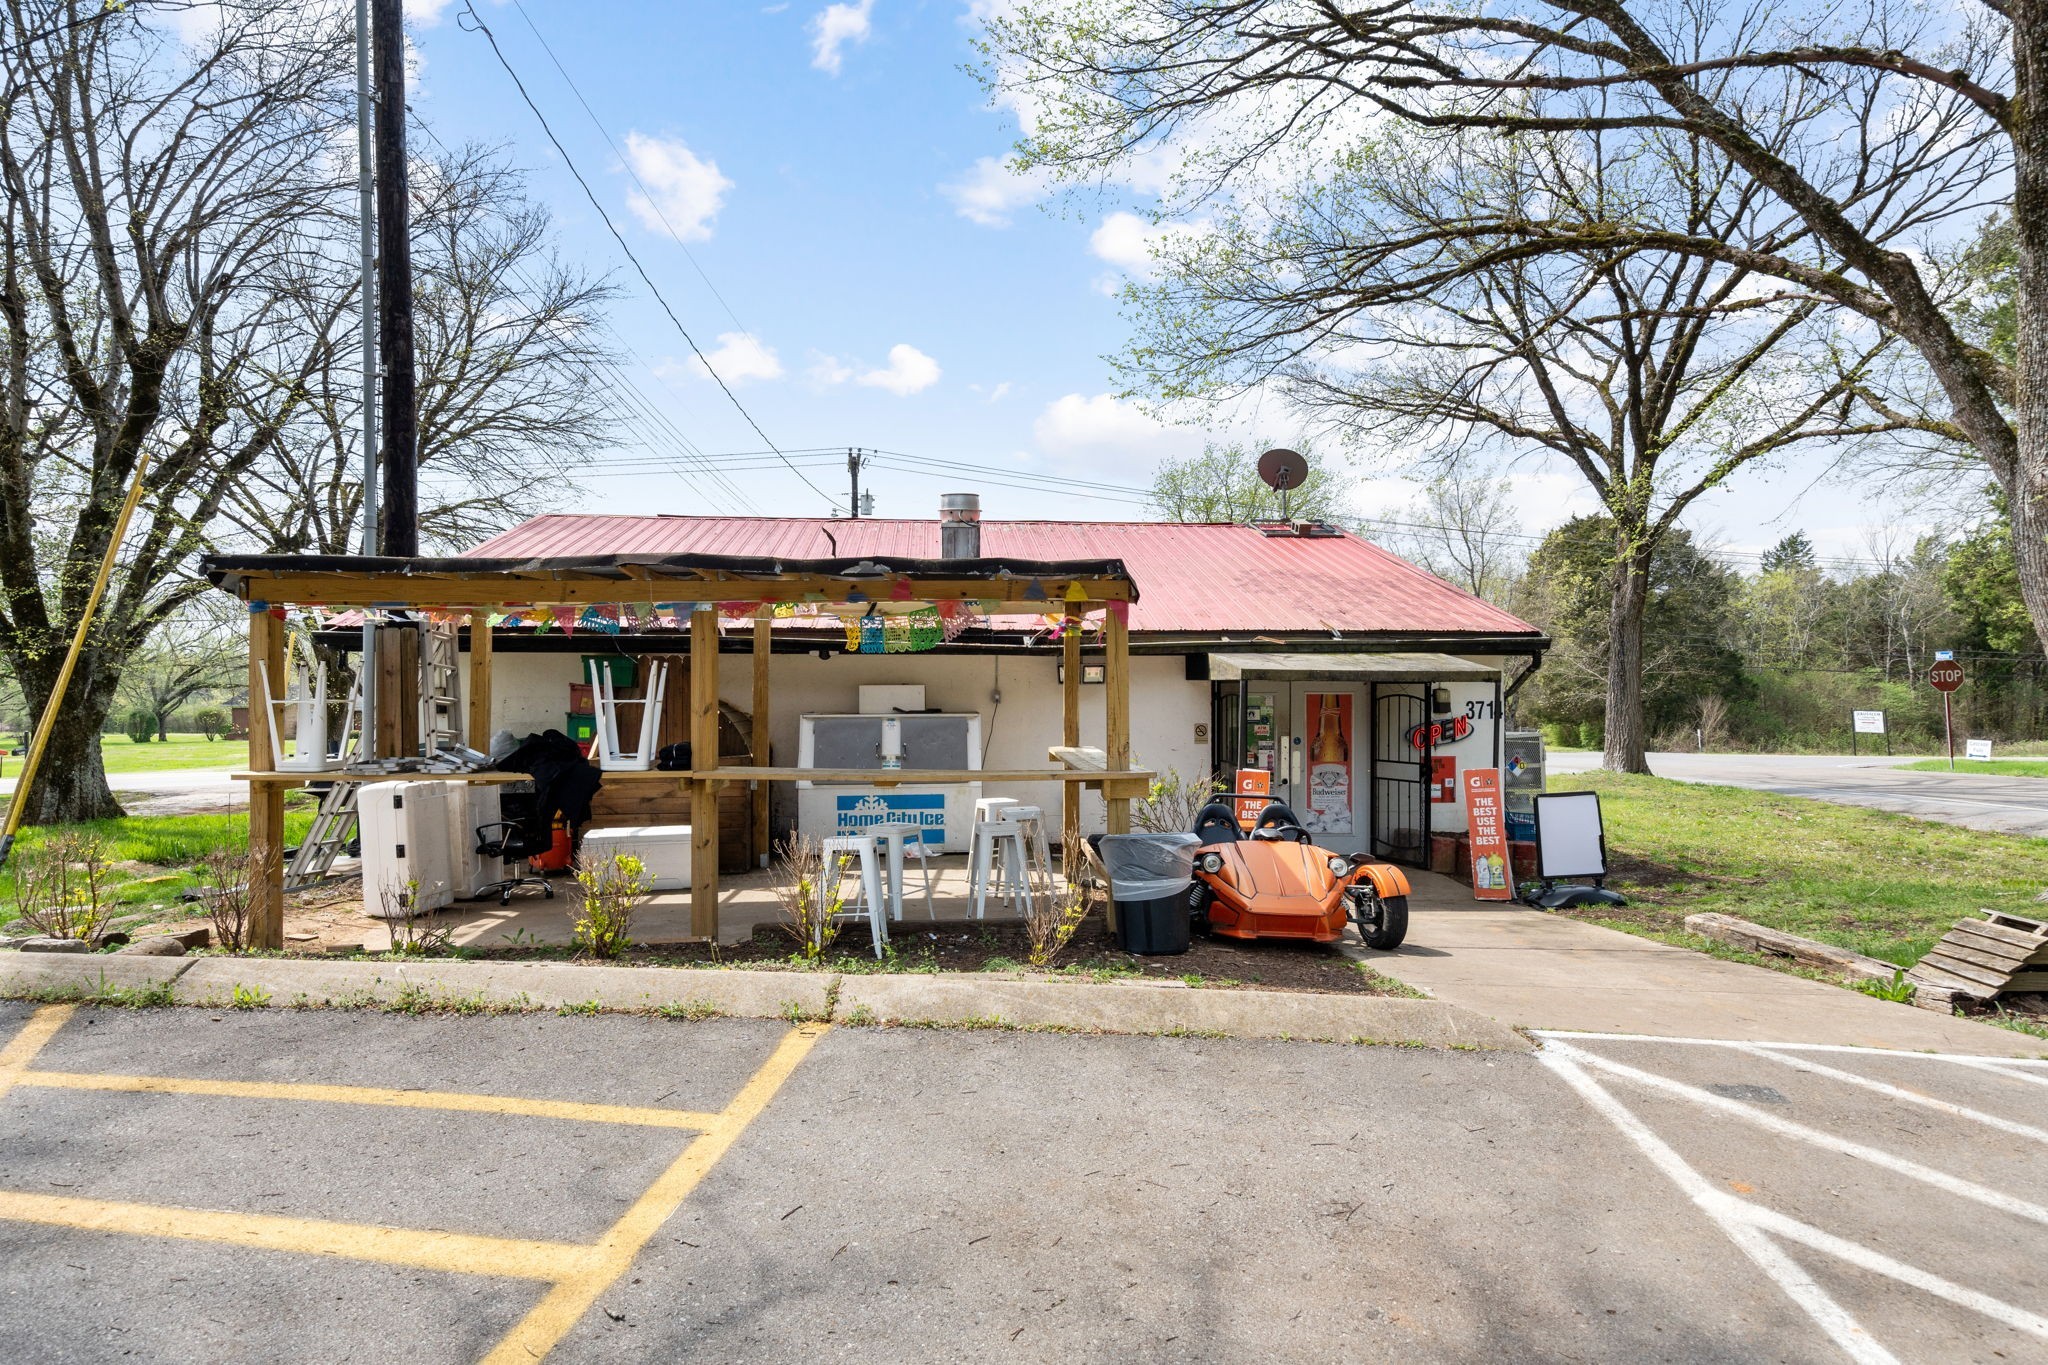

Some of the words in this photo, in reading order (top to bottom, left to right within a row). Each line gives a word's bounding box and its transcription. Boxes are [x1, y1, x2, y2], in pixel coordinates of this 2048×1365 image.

[1931, 670, 1962, 683] STOP
[1413, 714, 1469, 752] OPEN
[1242, 779, 1253, 790] G
[1470, 776, 1481, 788] G
[1312, 787, 1347, 796] Budweiser
[1244, 800, 1262, 809] THE
[1474, 798, 1494, 807] THE
[1241, 810, 1261, 820] BES
[1473, 807, 1498, 816] BEST
[837, 812, 884, 827] Home
[919, 811, 945, 826] Ice
[1476, 817, 1496, 826] USE
[1477, 826, 1497, 836] THE
[1476, 836, 1501, 846] BEST
